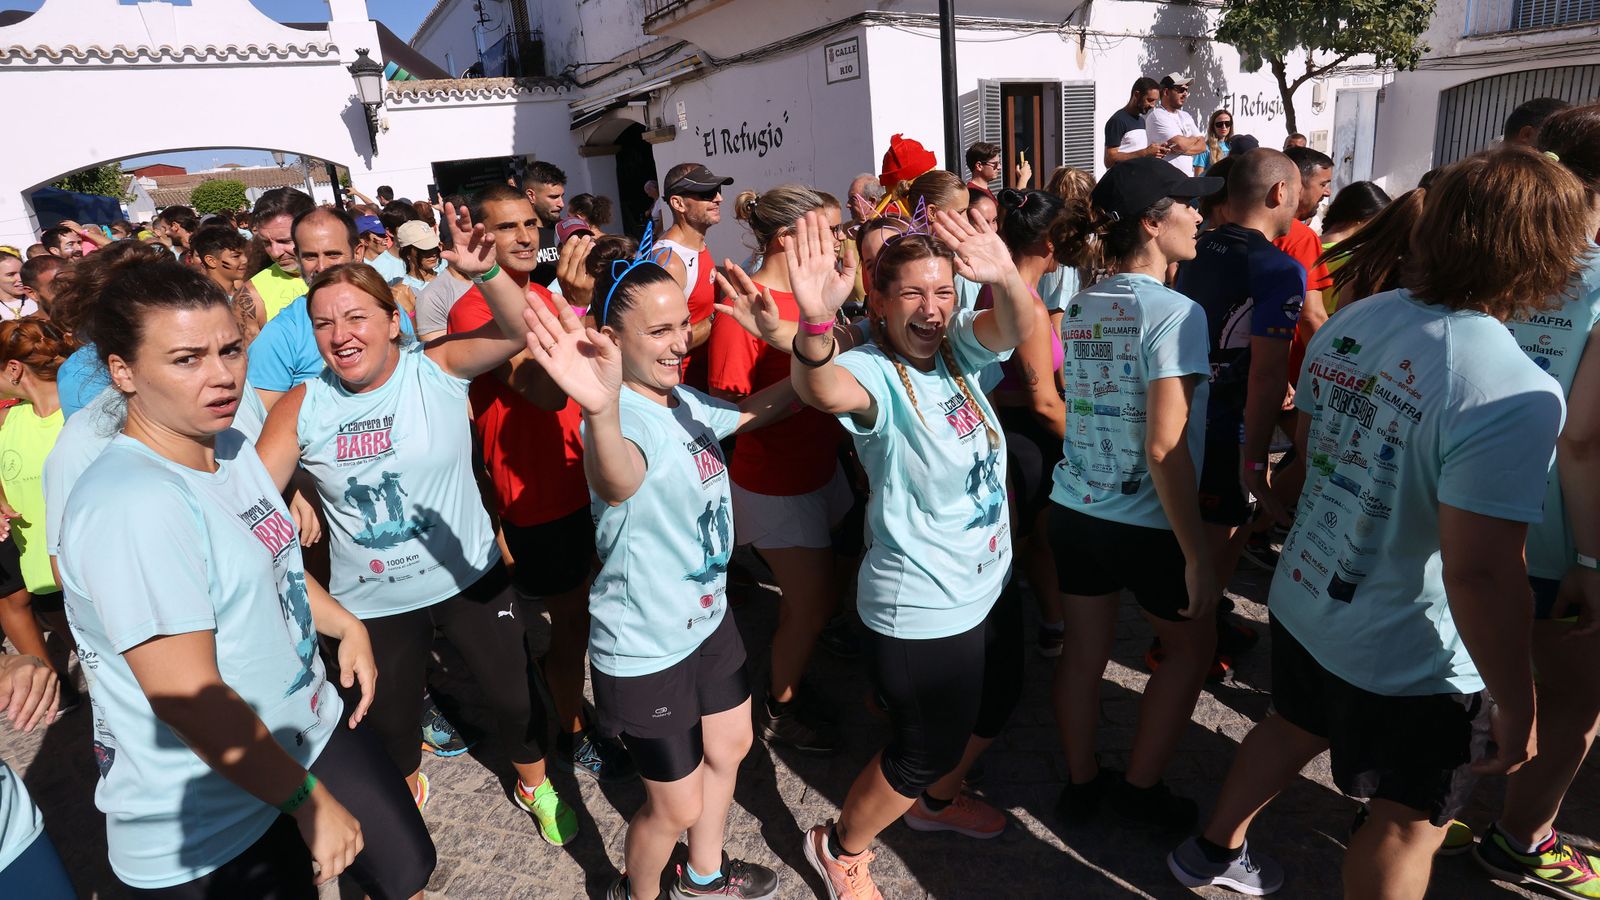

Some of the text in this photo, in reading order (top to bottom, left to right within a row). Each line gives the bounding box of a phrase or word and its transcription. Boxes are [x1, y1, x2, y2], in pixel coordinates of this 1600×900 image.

[835, 45, 857, 58] CALLE
[840, 64, 853, 75] RIO
[1074, 342, 1090, 359] PURO
[386, 553, 420, 567] 1000 Km
